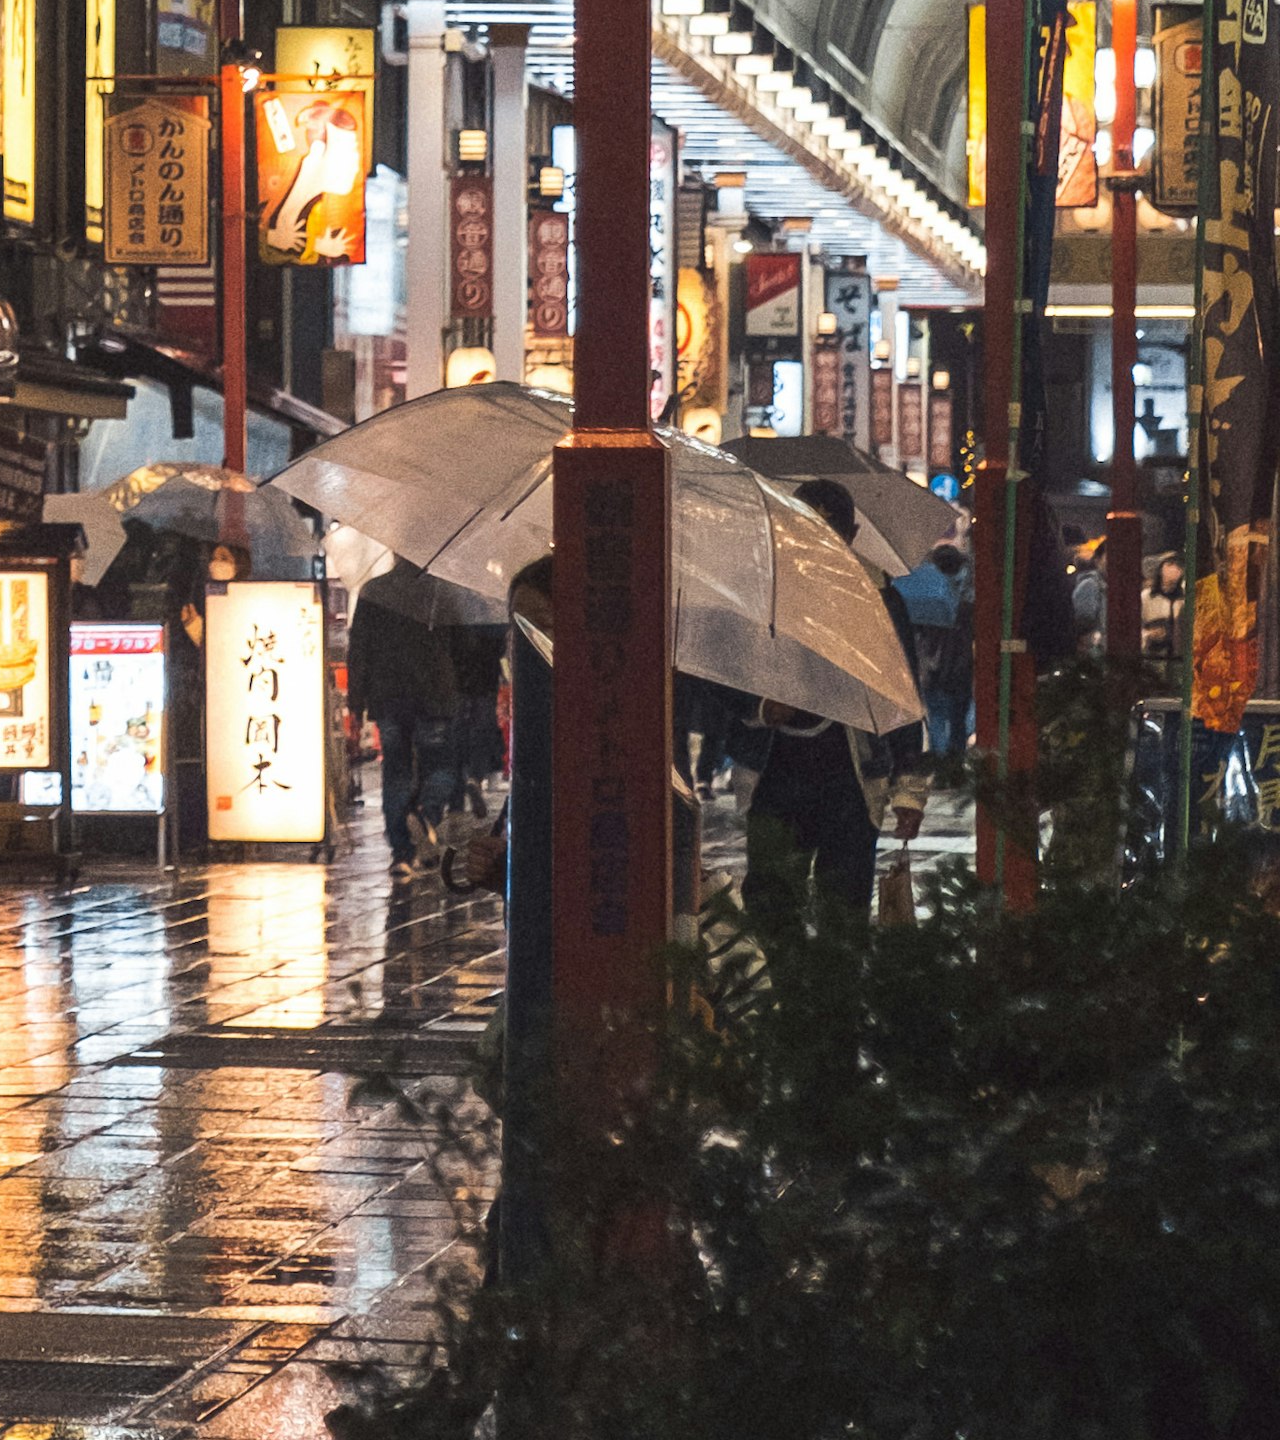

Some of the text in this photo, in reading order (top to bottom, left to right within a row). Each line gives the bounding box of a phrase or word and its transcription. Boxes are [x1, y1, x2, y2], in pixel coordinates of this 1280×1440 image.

[158, 117, 185, 248] かんのん通り
[834, 284, 864, 353] そば
[238, 622, 293, 796] 焼肉岡本
